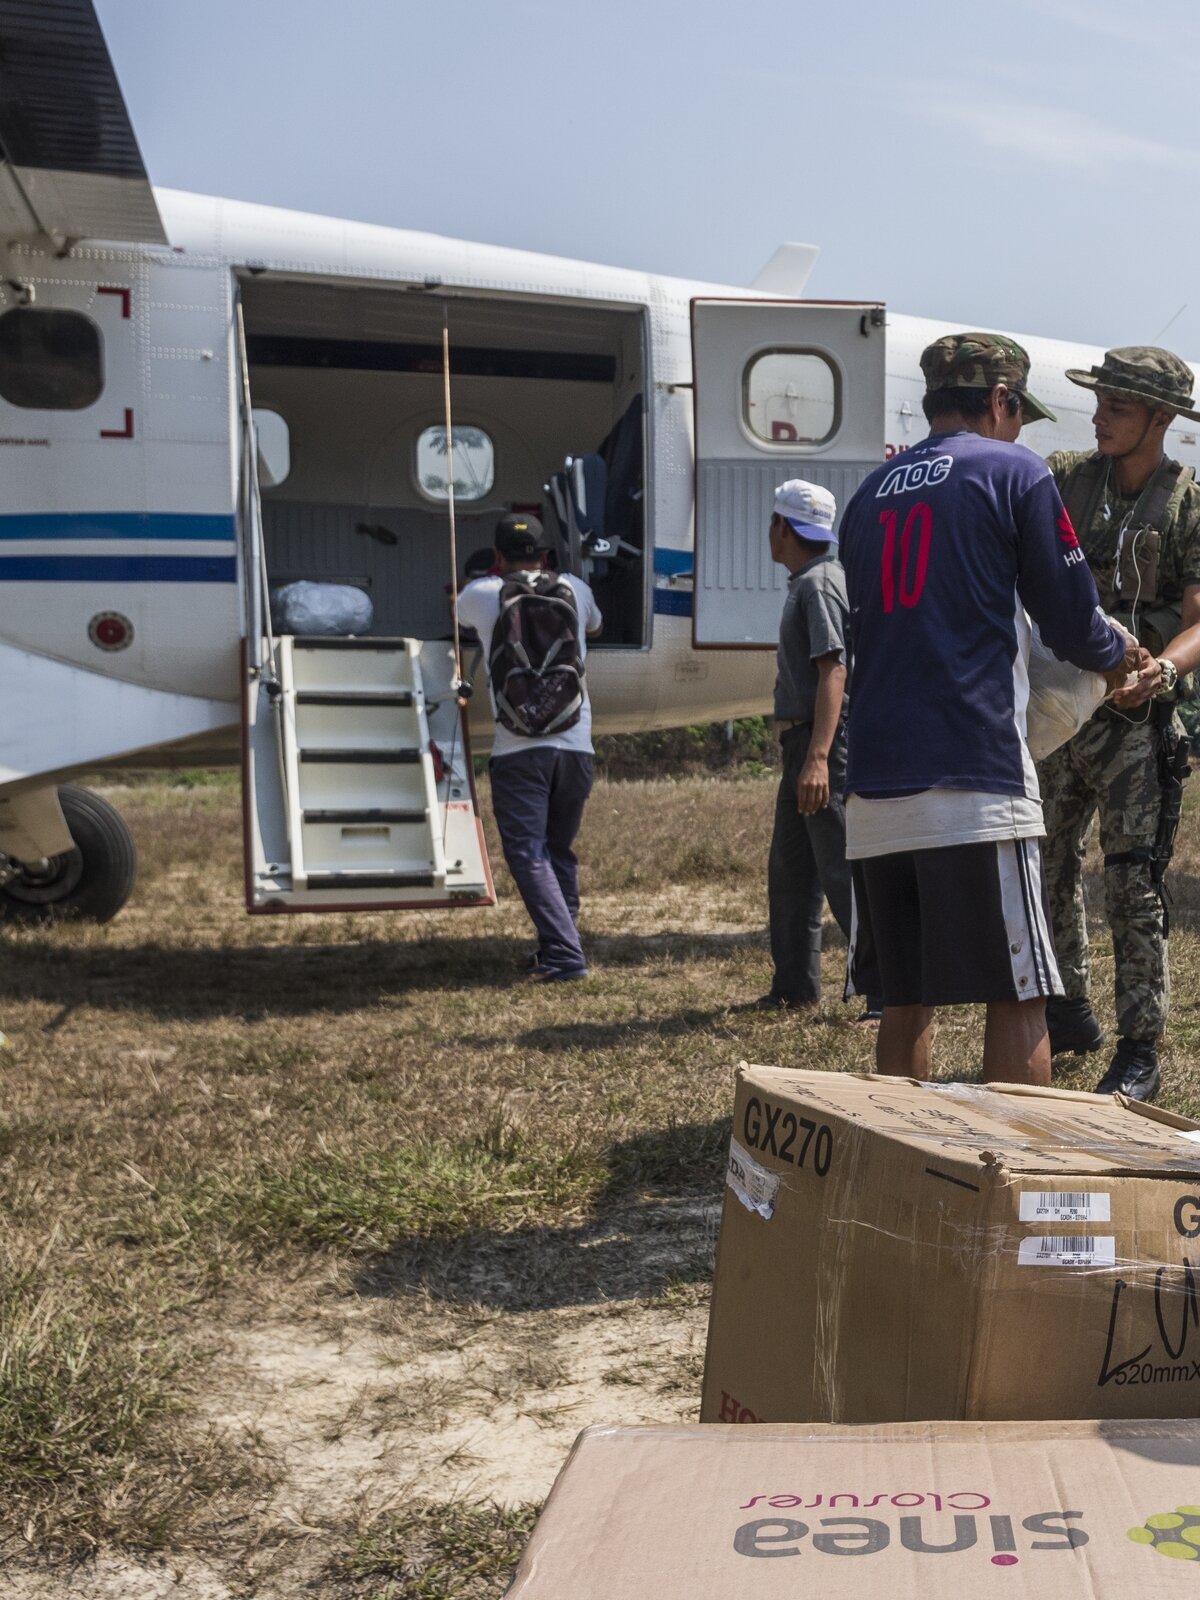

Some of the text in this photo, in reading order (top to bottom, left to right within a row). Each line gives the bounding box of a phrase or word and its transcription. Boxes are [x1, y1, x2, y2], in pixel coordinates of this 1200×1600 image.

[879, 500, 933, 614] 10
[744, 1097, 833, 1177] GX270
[733, 1510, 1090, 1567] sinea
